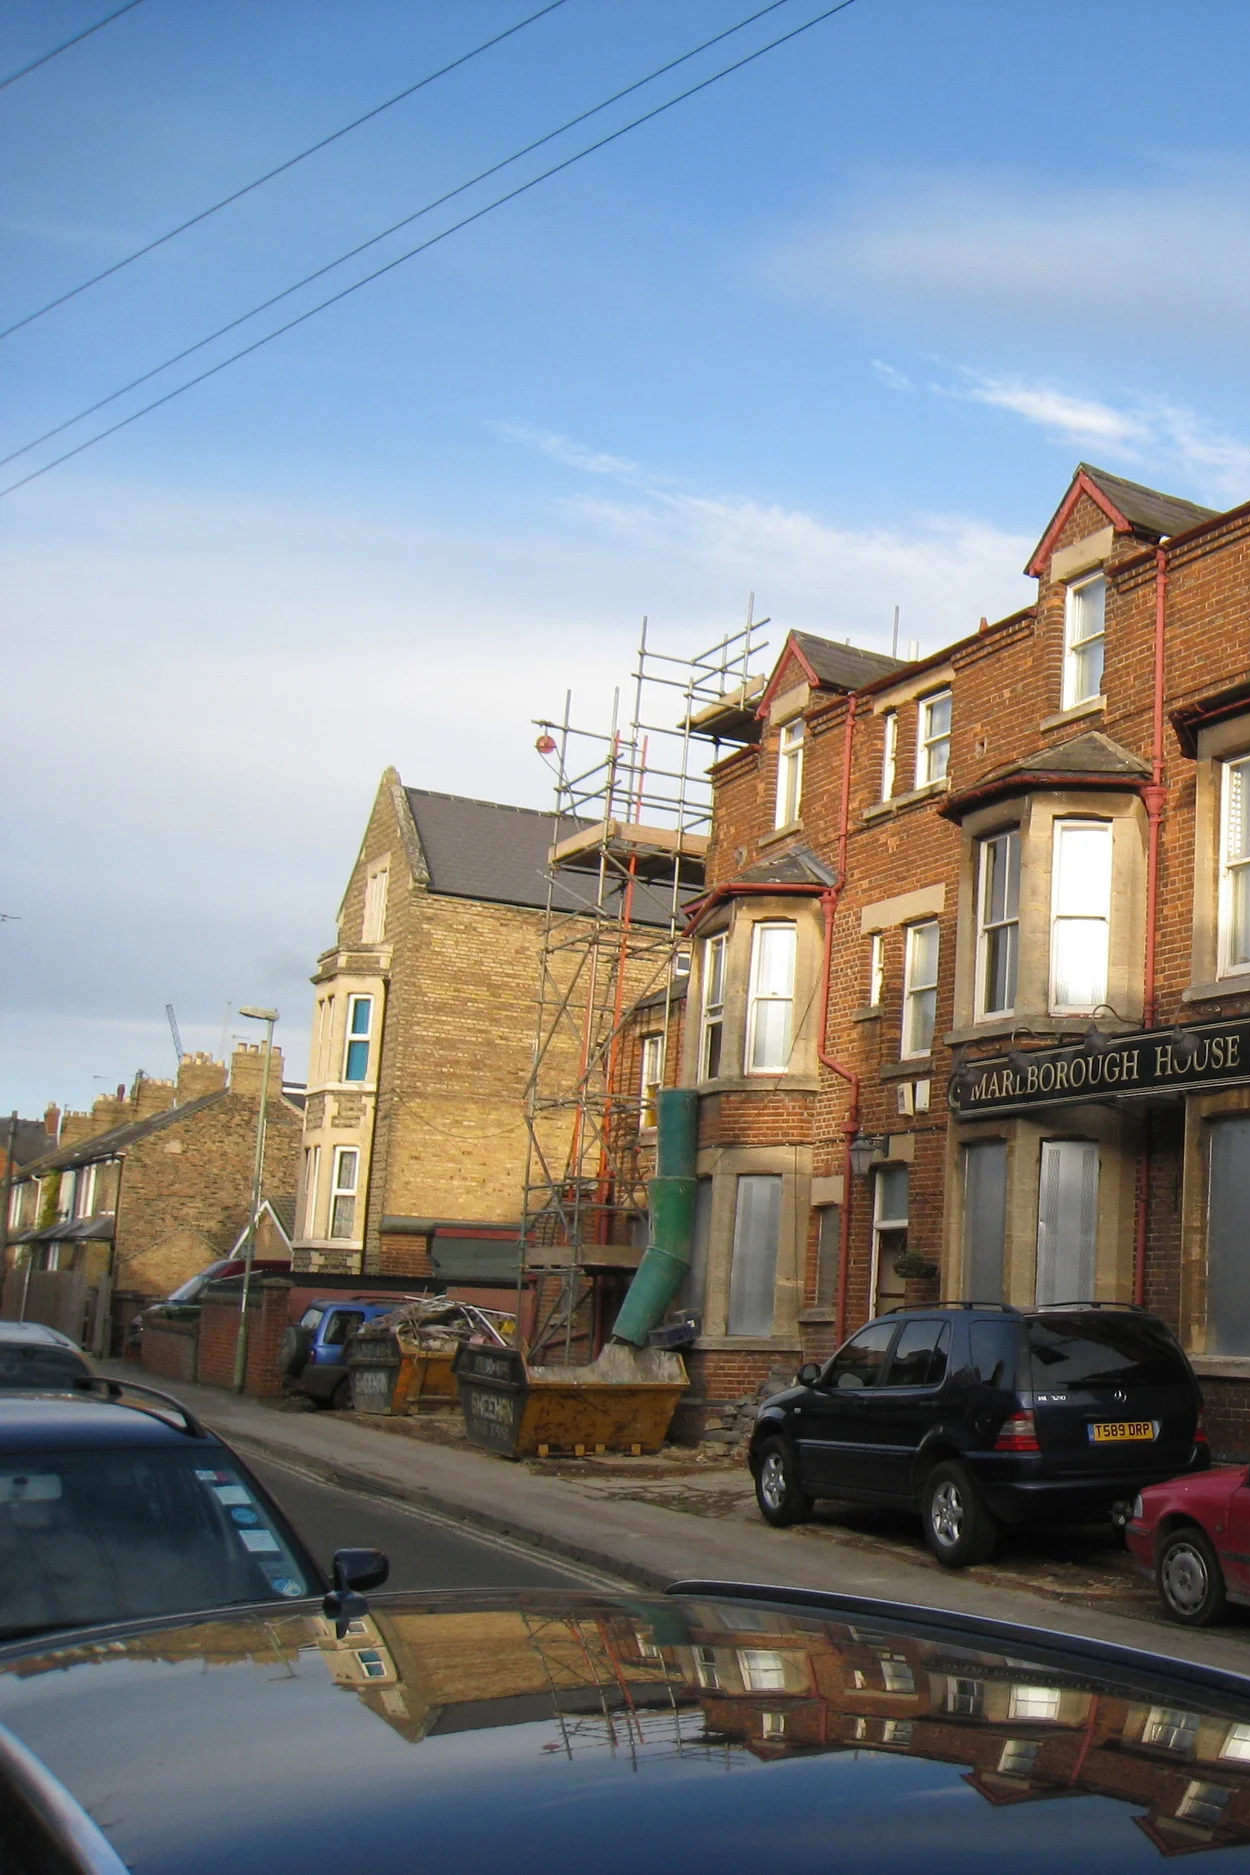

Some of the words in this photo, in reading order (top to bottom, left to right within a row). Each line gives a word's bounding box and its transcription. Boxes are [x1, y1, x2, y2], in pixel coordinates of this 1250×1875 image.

[970, 1052, 1140, 1101] MARLBOROUGH
[1154, 1034, 1240, 1077] HOUSE
[1095, 1423, 1126, 1438] T589
[1128, 1422, 1150, 1436] DRP
